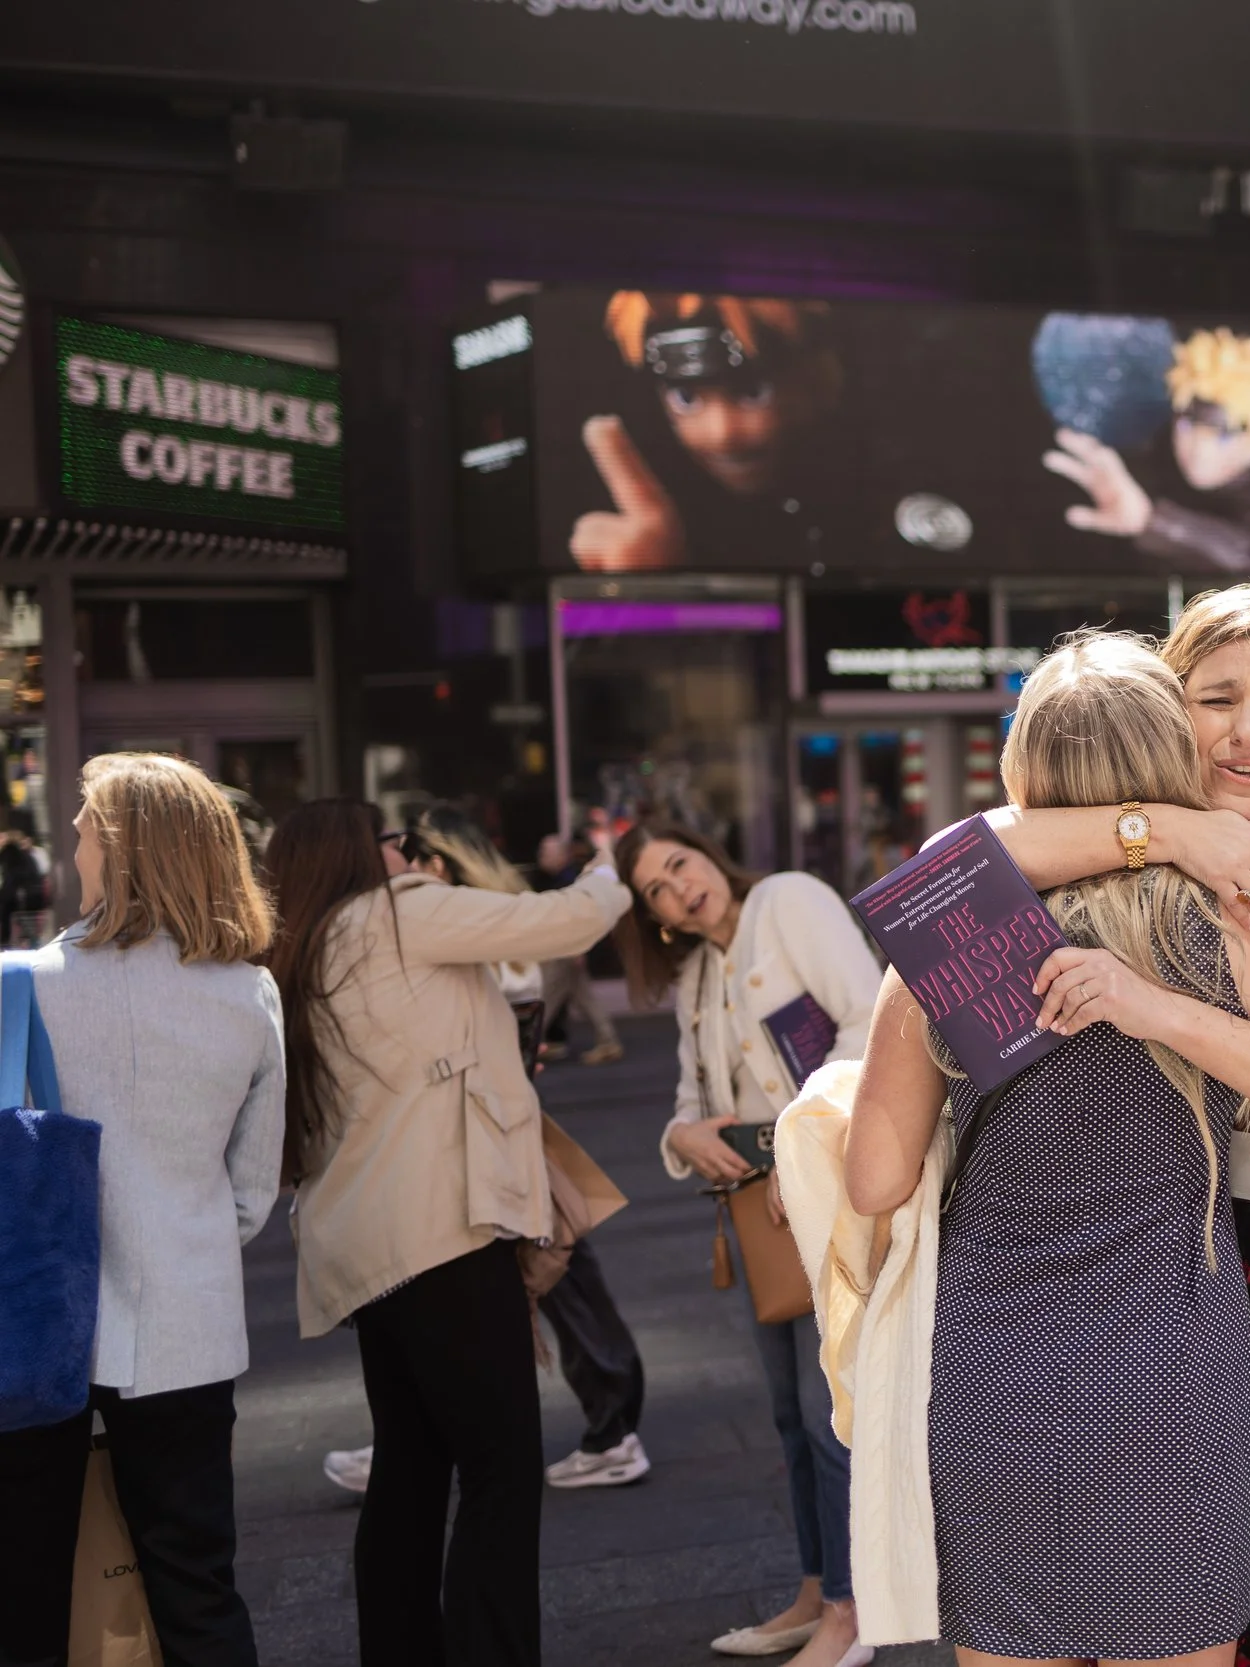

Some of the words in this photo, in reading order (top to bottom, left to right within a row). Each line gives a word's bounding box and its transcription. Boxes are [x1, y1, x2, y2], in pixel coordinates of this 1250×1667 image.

[65, 352, 341, 447] STARBUCKS
[120, 429, 295, 500] COFFEE
[883, 916, 907, 932] Women
[904, 889, 946, 919] Entrepreneurs
[950, 874, 967, 888] Scale
[965, 865, 978, 878] and
[976, 857, 990, 870] Sell
[899, 900, 912, 910] The
[909, 887, 930, 903] Secret
[927, 872, 953, 891] Formula
[949, 865, 961, 878] for
[907, 919, 918, 931] for
[916, 892, 958, 923] Life-Changing
[954, 881, 975, 897] Money
[930, 902, 985, 951] THE
[909, 903, 1061, 1022] WHISPER
[1000, 1034, 1032, 1059] CARRIE
[1030, 1025, 1049, 1039] KE
